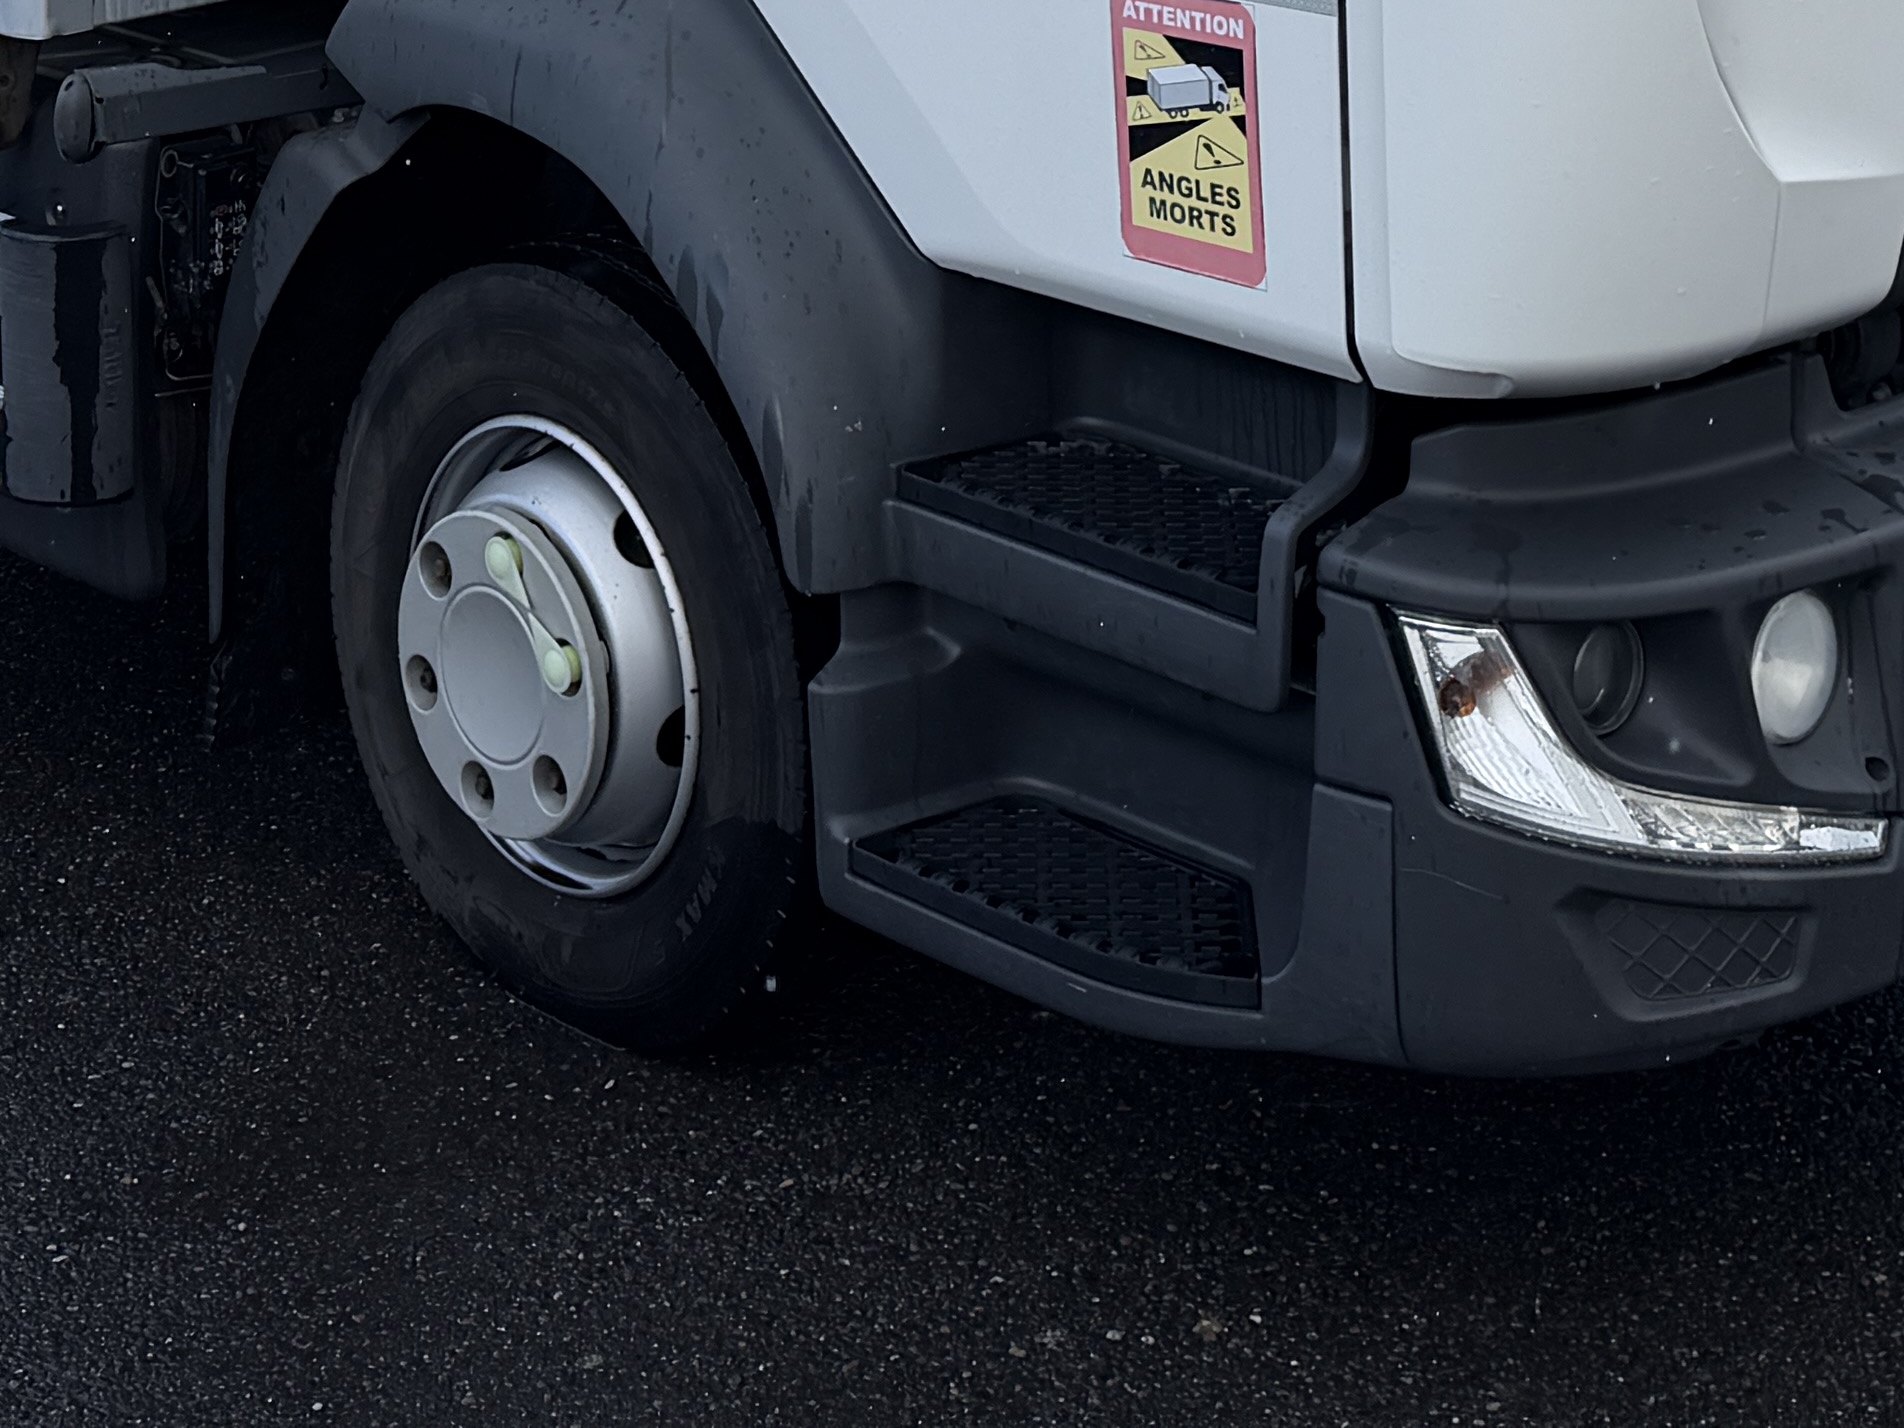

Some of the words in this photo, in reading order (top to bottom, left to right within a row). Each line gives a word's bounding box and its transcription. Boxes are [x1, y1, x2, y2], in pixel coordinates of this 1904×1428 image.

[1122, 0, 1244, 39] ATTENTION
[1141, 168, 1240, 210] ANGLES
[1149, 196, 1236, 237] MORTS
